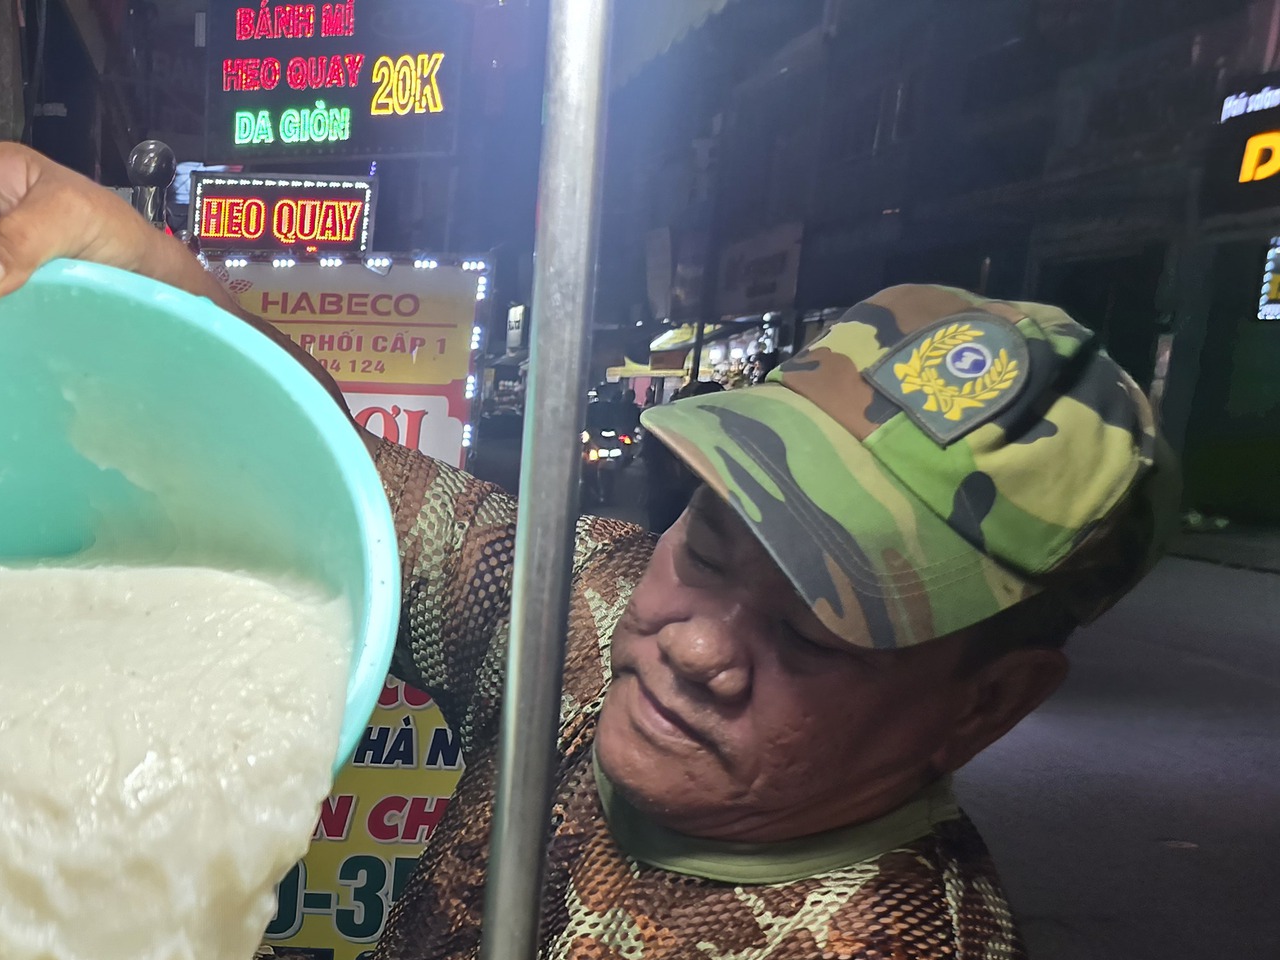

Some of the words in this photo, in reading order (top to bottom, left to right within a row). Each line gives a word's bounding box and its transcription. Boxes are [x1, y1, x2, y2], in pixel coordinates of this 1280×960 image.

[236, 0, 315, 40] BÁNH
[223, 57, 281, 91] HEO
[286, 53, 365, 91] QUAY
[370, 53, 445, 115] 20K
[235, 110, 274, 144] DA
[201, 197, 265, 238] HEO
[273, 199, 362, 243] QUAY
[261, 291, 420, 317] HABECO
[300, 329, 363, 352] PHỐI
[372, 331, 426, 353] CẤP
[436, 338, 446, 354] 1
[349, 360, 386, 374] 124
